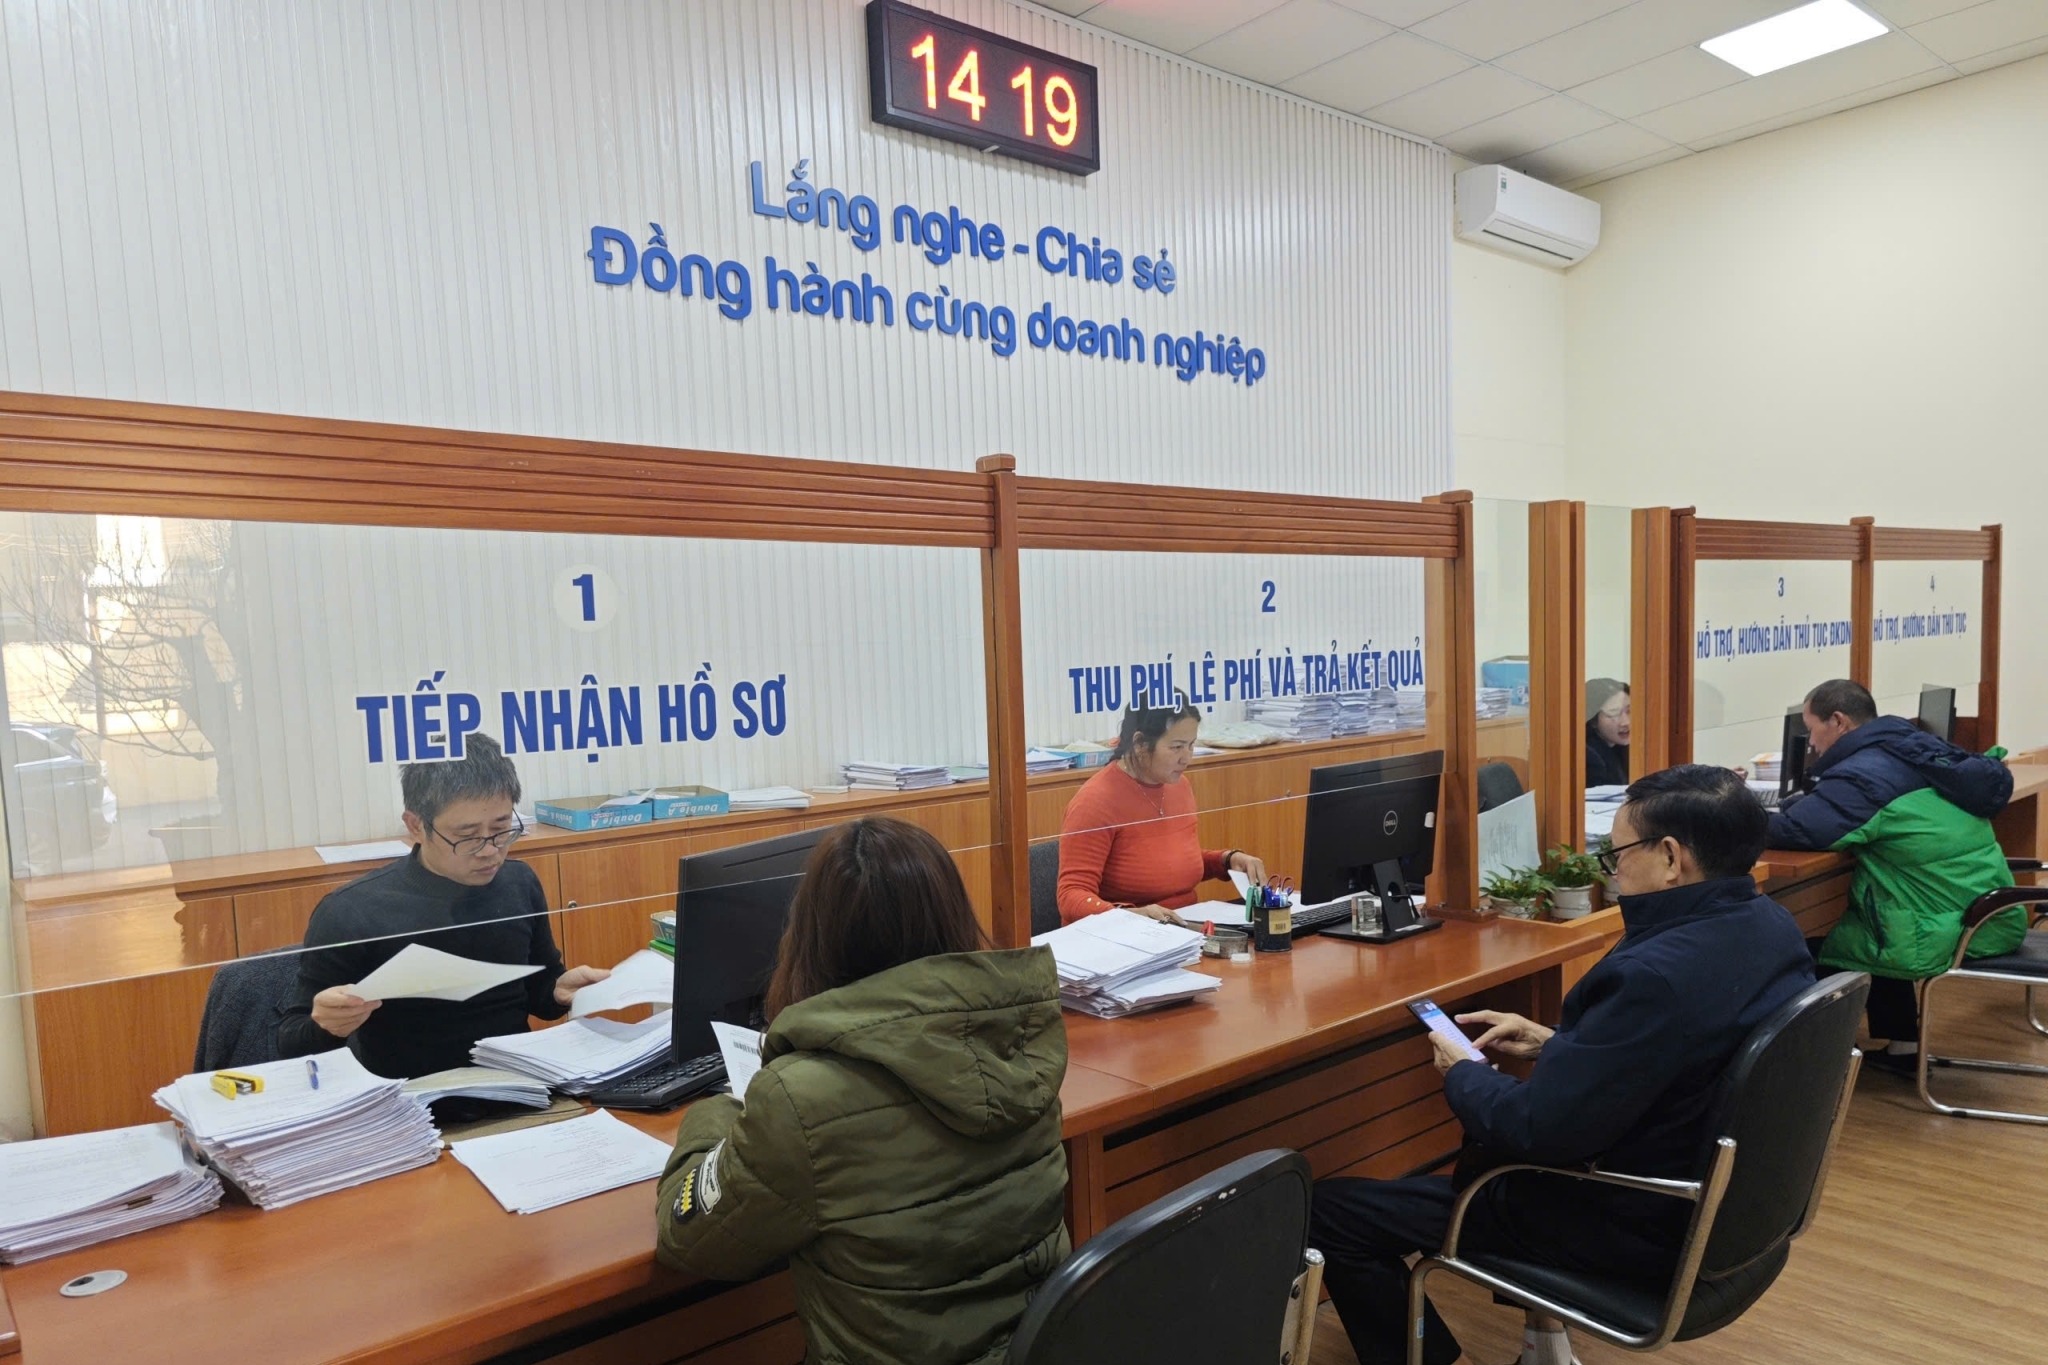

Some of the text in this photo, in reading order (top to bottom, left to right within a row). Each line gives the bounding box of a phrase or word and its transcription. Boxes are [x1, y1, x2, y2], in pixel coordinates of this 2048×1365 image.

[911, 33, 1078, 147] 14 19
[751, 159, 880, 251] Lắng
[894, 204, 1004, 266] nghe
[1037, 225, 1122, 282] Chia
[1132, 248, 1177, 295] sẻ
[587, 222, 1266, 386] Đồng hành cùng doanh nghiệp
[572, 573, 596, 622] 1
[1261, 580, 1277, 613] 2
[1778, 576, 1785, 598] 3
[1929, 574, 1936, 593] 4
[1697, 620, 1711, 659] HỖ
[1714, 625, 1735, 663] TRỢ,
[1738, 621, 1770, 655] HƯỚNG
[1773, 614, 1791, 652] DẪN
[1794, 613, 1810, 650] THỦ
[1812, 622, 1828, 654] TỤC
[1069, 635, 1424, 714] THU PHÍ, LỆ PHÍ VÀ TRẢ KẾT QUẢ
[356, 661, 787, 764] TIẾP NHẬN HỒ SƠ
[602, 813, 643, 825] Double
[679, 803, 719, 814] Double
